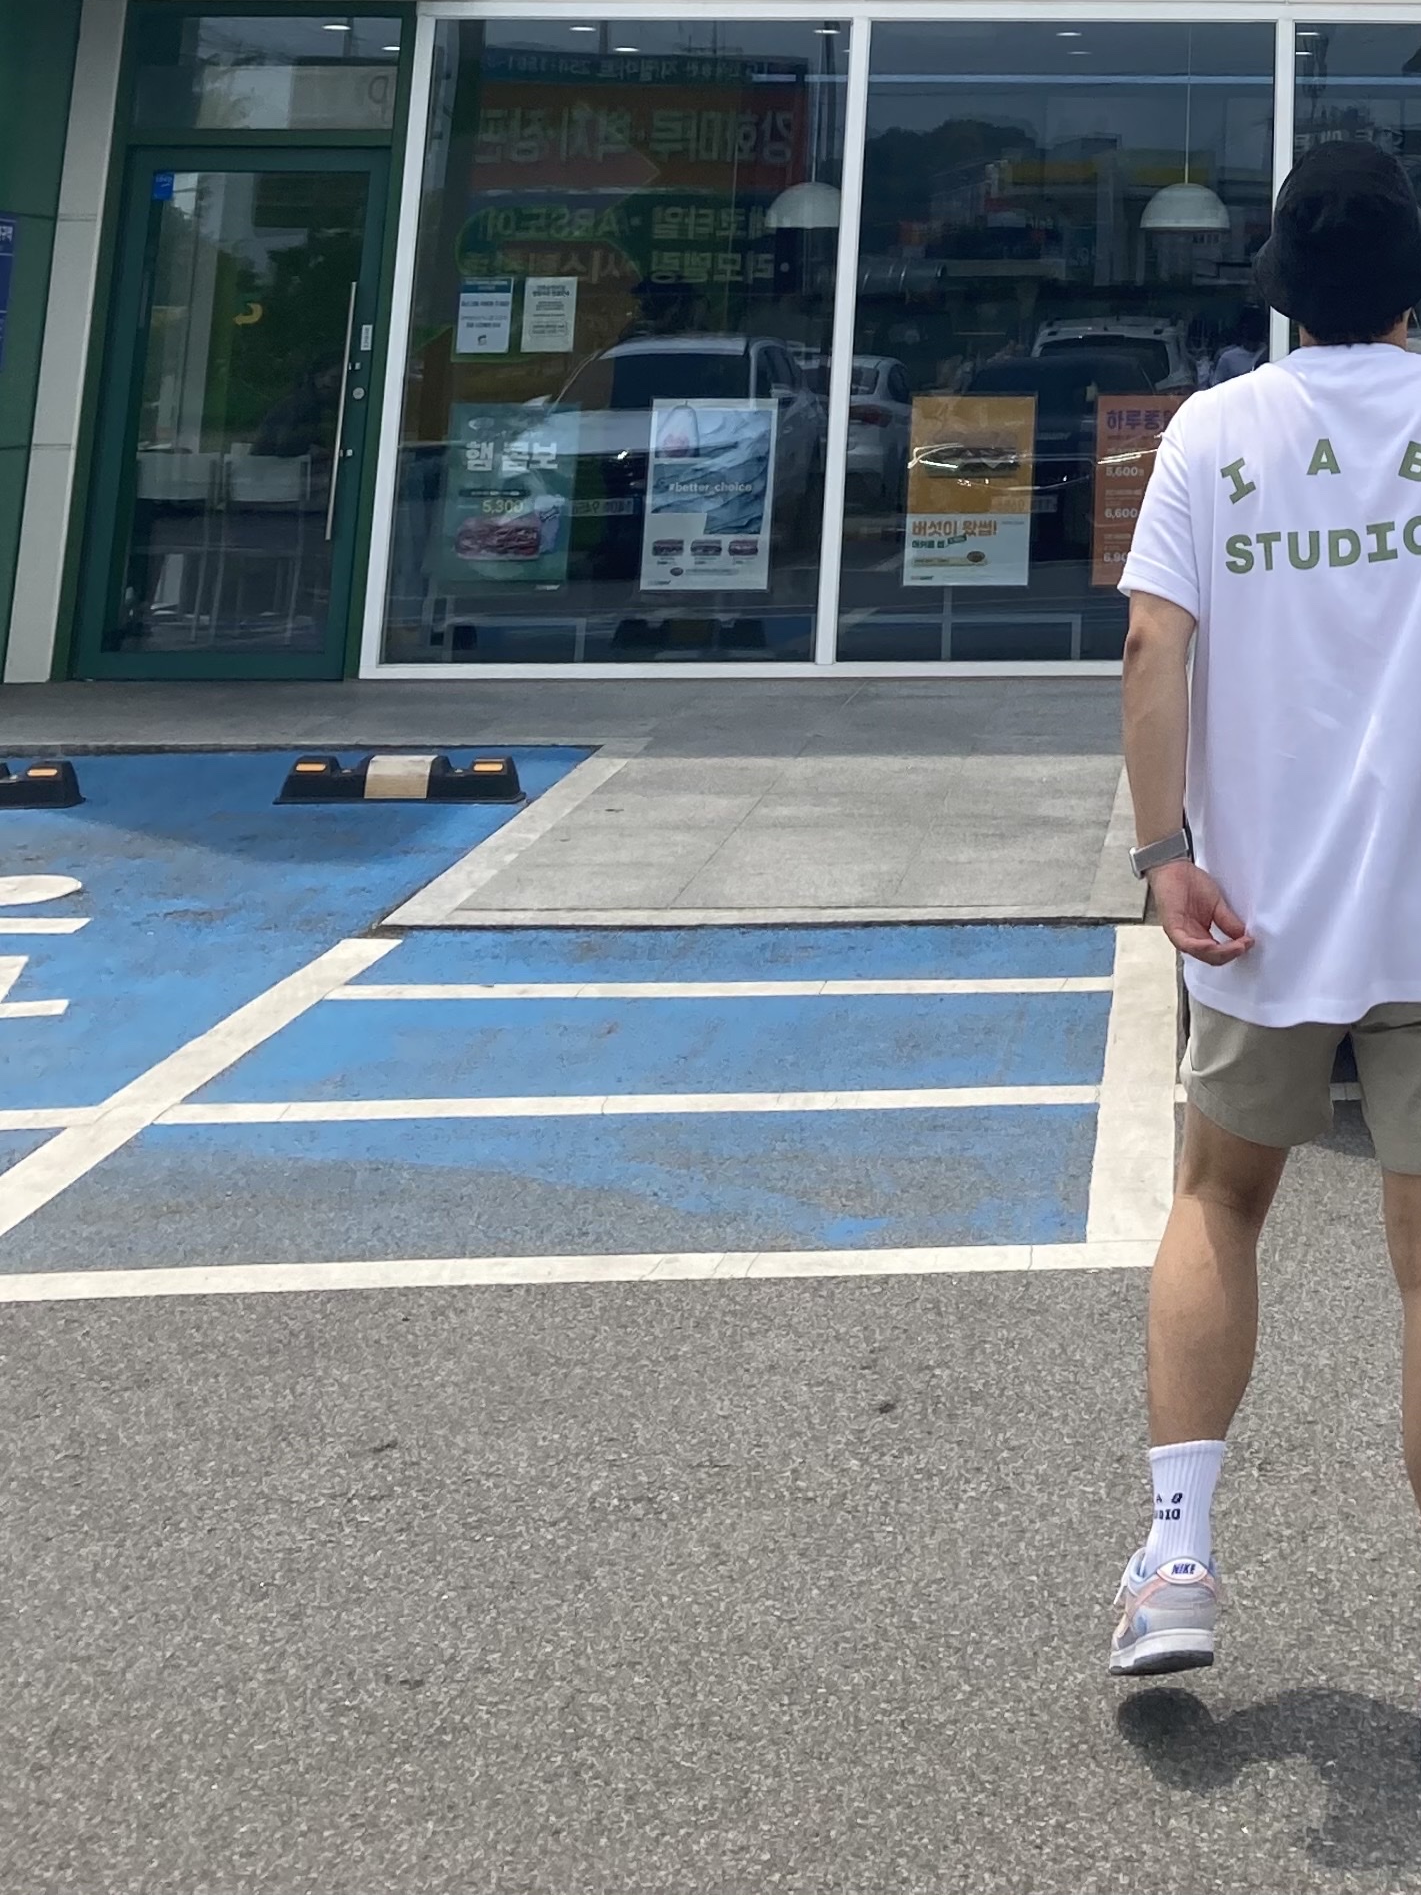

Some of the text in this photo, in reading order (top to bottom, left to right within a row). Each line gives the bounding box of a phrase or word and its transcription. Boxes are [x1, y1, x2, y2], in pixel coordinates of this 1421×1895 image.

[465, 440, 495, 472] 햄
[911, 520, 958, 537] 버섯이
[1171, 1564, 1196, 1574] NIKE
